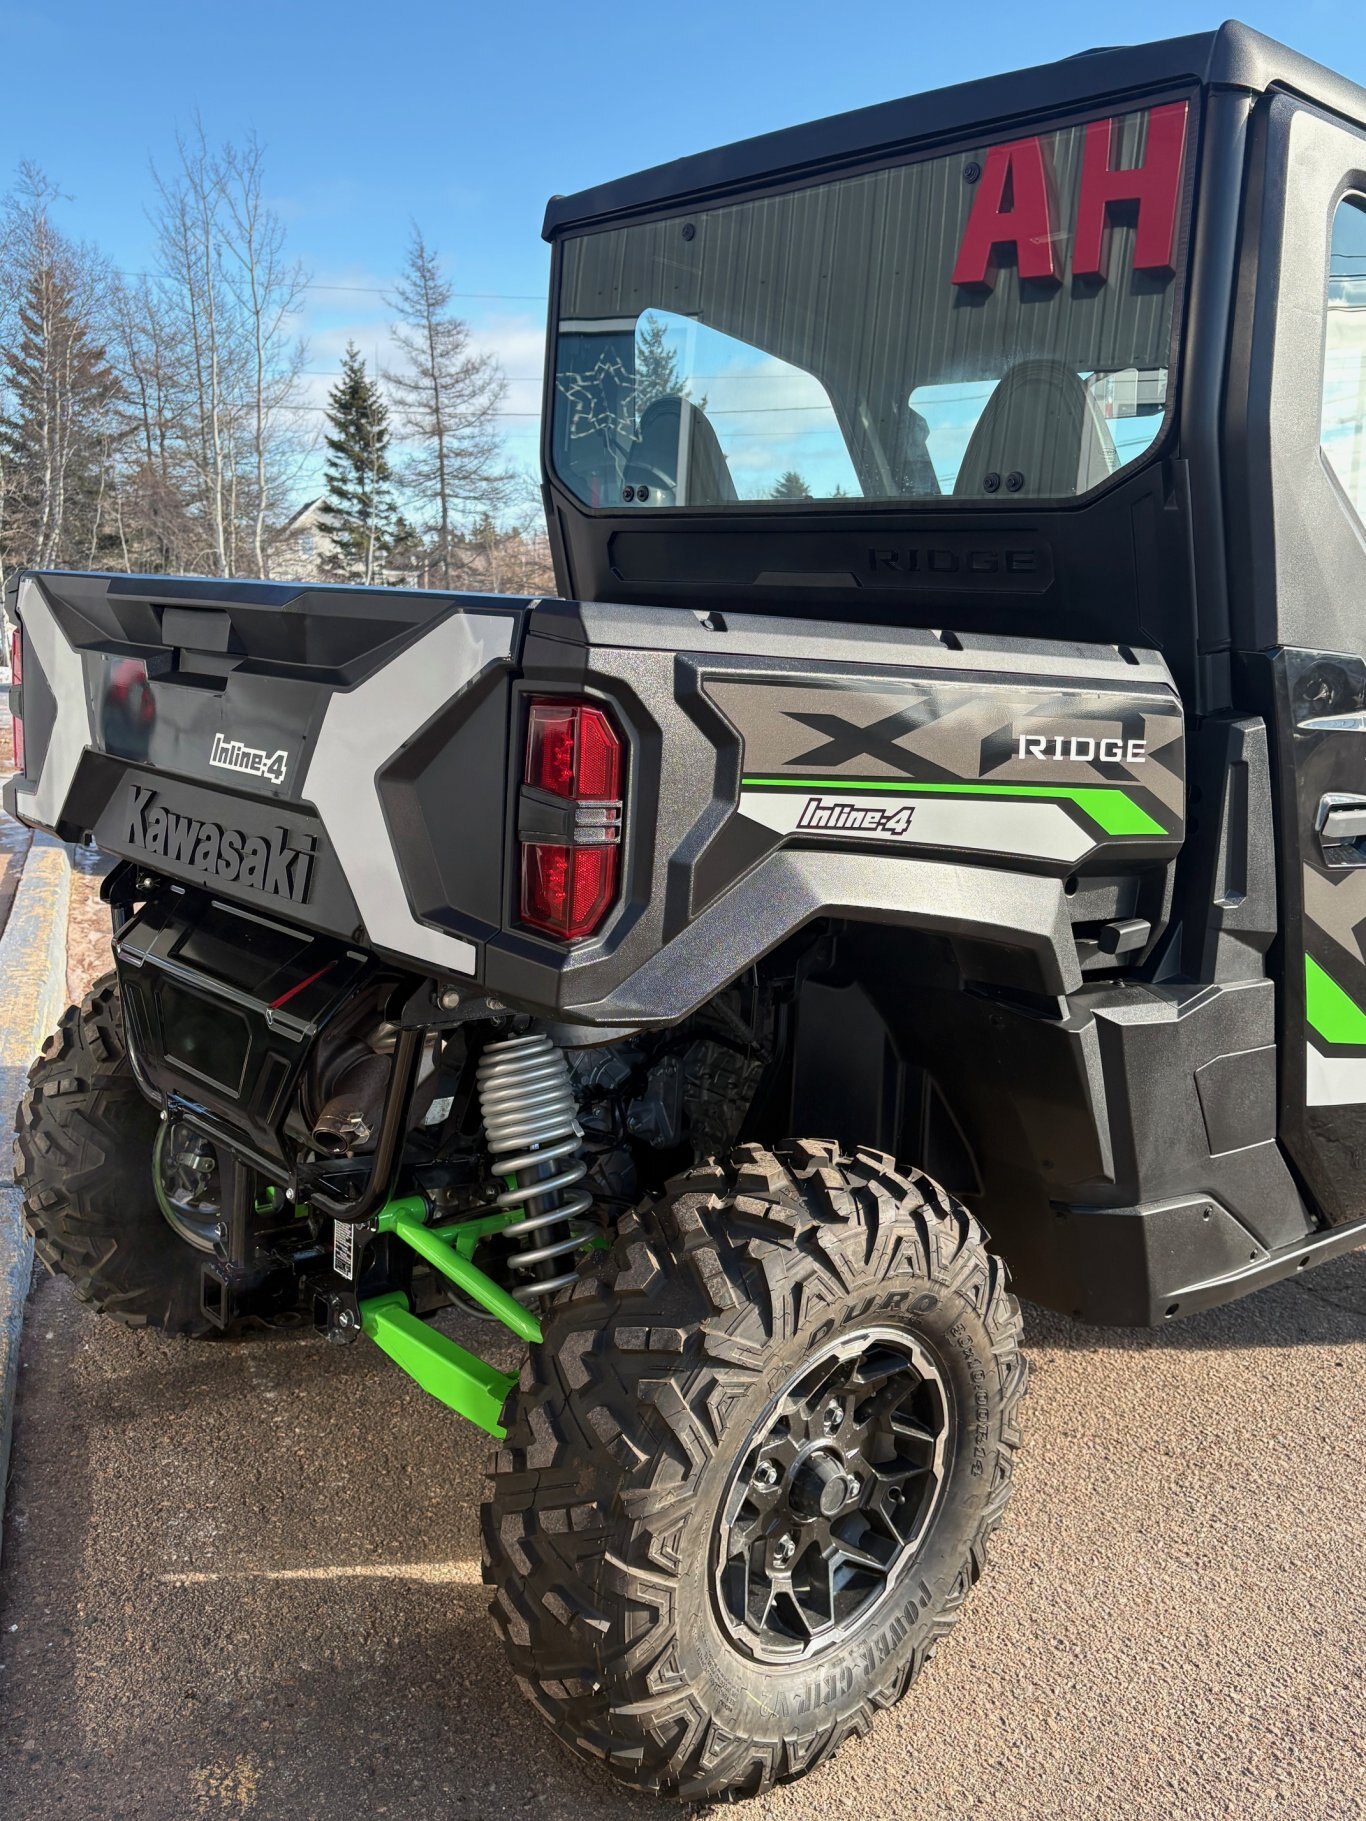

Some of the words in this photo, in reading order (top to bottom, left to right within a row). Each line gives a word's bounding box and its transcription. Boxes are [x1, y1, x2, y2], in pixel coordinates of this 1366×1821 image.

[868, 548, 1038, 574] RIDGE
[210, 733, 288, 784] Inline-4
[1018, 734, 1147, 763] RIDGE
[796, 798, 915, 835] Inline-4
[126, 784, 318, 904] Kawasaki
[806, 1288, 939, 1350] DURO
[863, 1578, 933, 1676] POWER
[797, 1665, 854, 1714] GRIP
